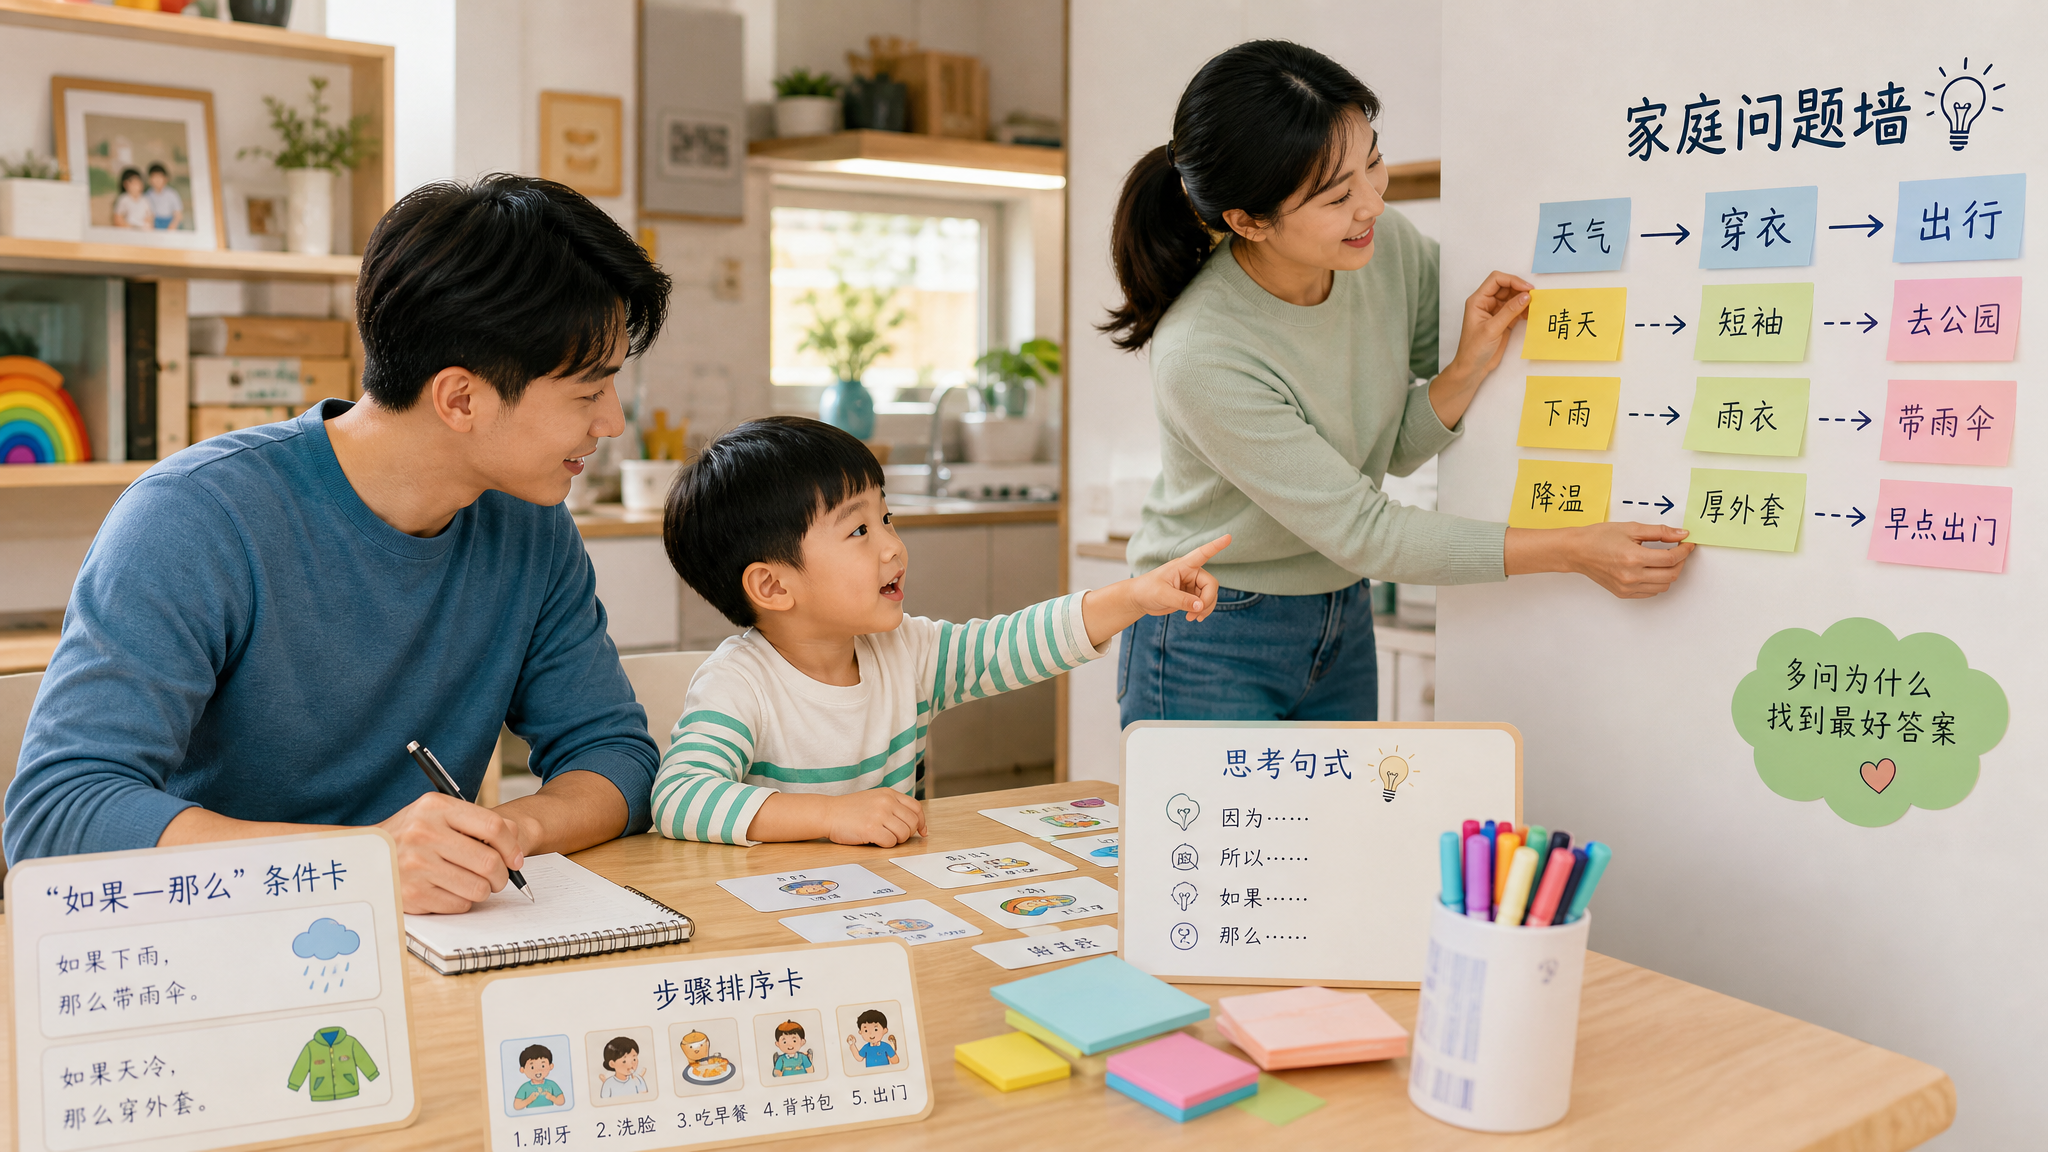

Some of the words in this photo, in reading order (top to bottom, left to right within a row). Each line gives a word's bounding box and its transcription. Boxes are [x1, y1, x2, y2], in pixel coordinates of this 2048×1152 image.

[1626, 80, 1912, 162] 家庭问题墙
[1552, 217, 1611, 254] 天气
[1720, 206, 1792, 252] 穿衣
[1919, 199, 2003, 242] 出行
[1548, 308, 1597, 341] 晴天
[1718, 306, 1783, 338] 短袖
[1907, 302, 2001, 336] 去公园
[1544, 399, 1591, 428] 下雨
[1717, 399, 1778, 433] 雨衣
[1898, 403, 1995, 442] 带雨伞
[1531, 480, 1584, 513] 降温
[1699, 489, 1785, 528] 厚外套
[1884, 507, 1997, 547] 早点出门
[1787, 657, 1931, 699] 多问为什么
[1766, 701, 1956, 746] 找到最好答案
[1222, 747, 1352, 780] 思考句式
[59, 980, 197, 1016] 那么带雨伞。
[653, 967, 804, 1011] 步骤排序卡
[64, 1090, 206, 1130] 那么穿外套。
